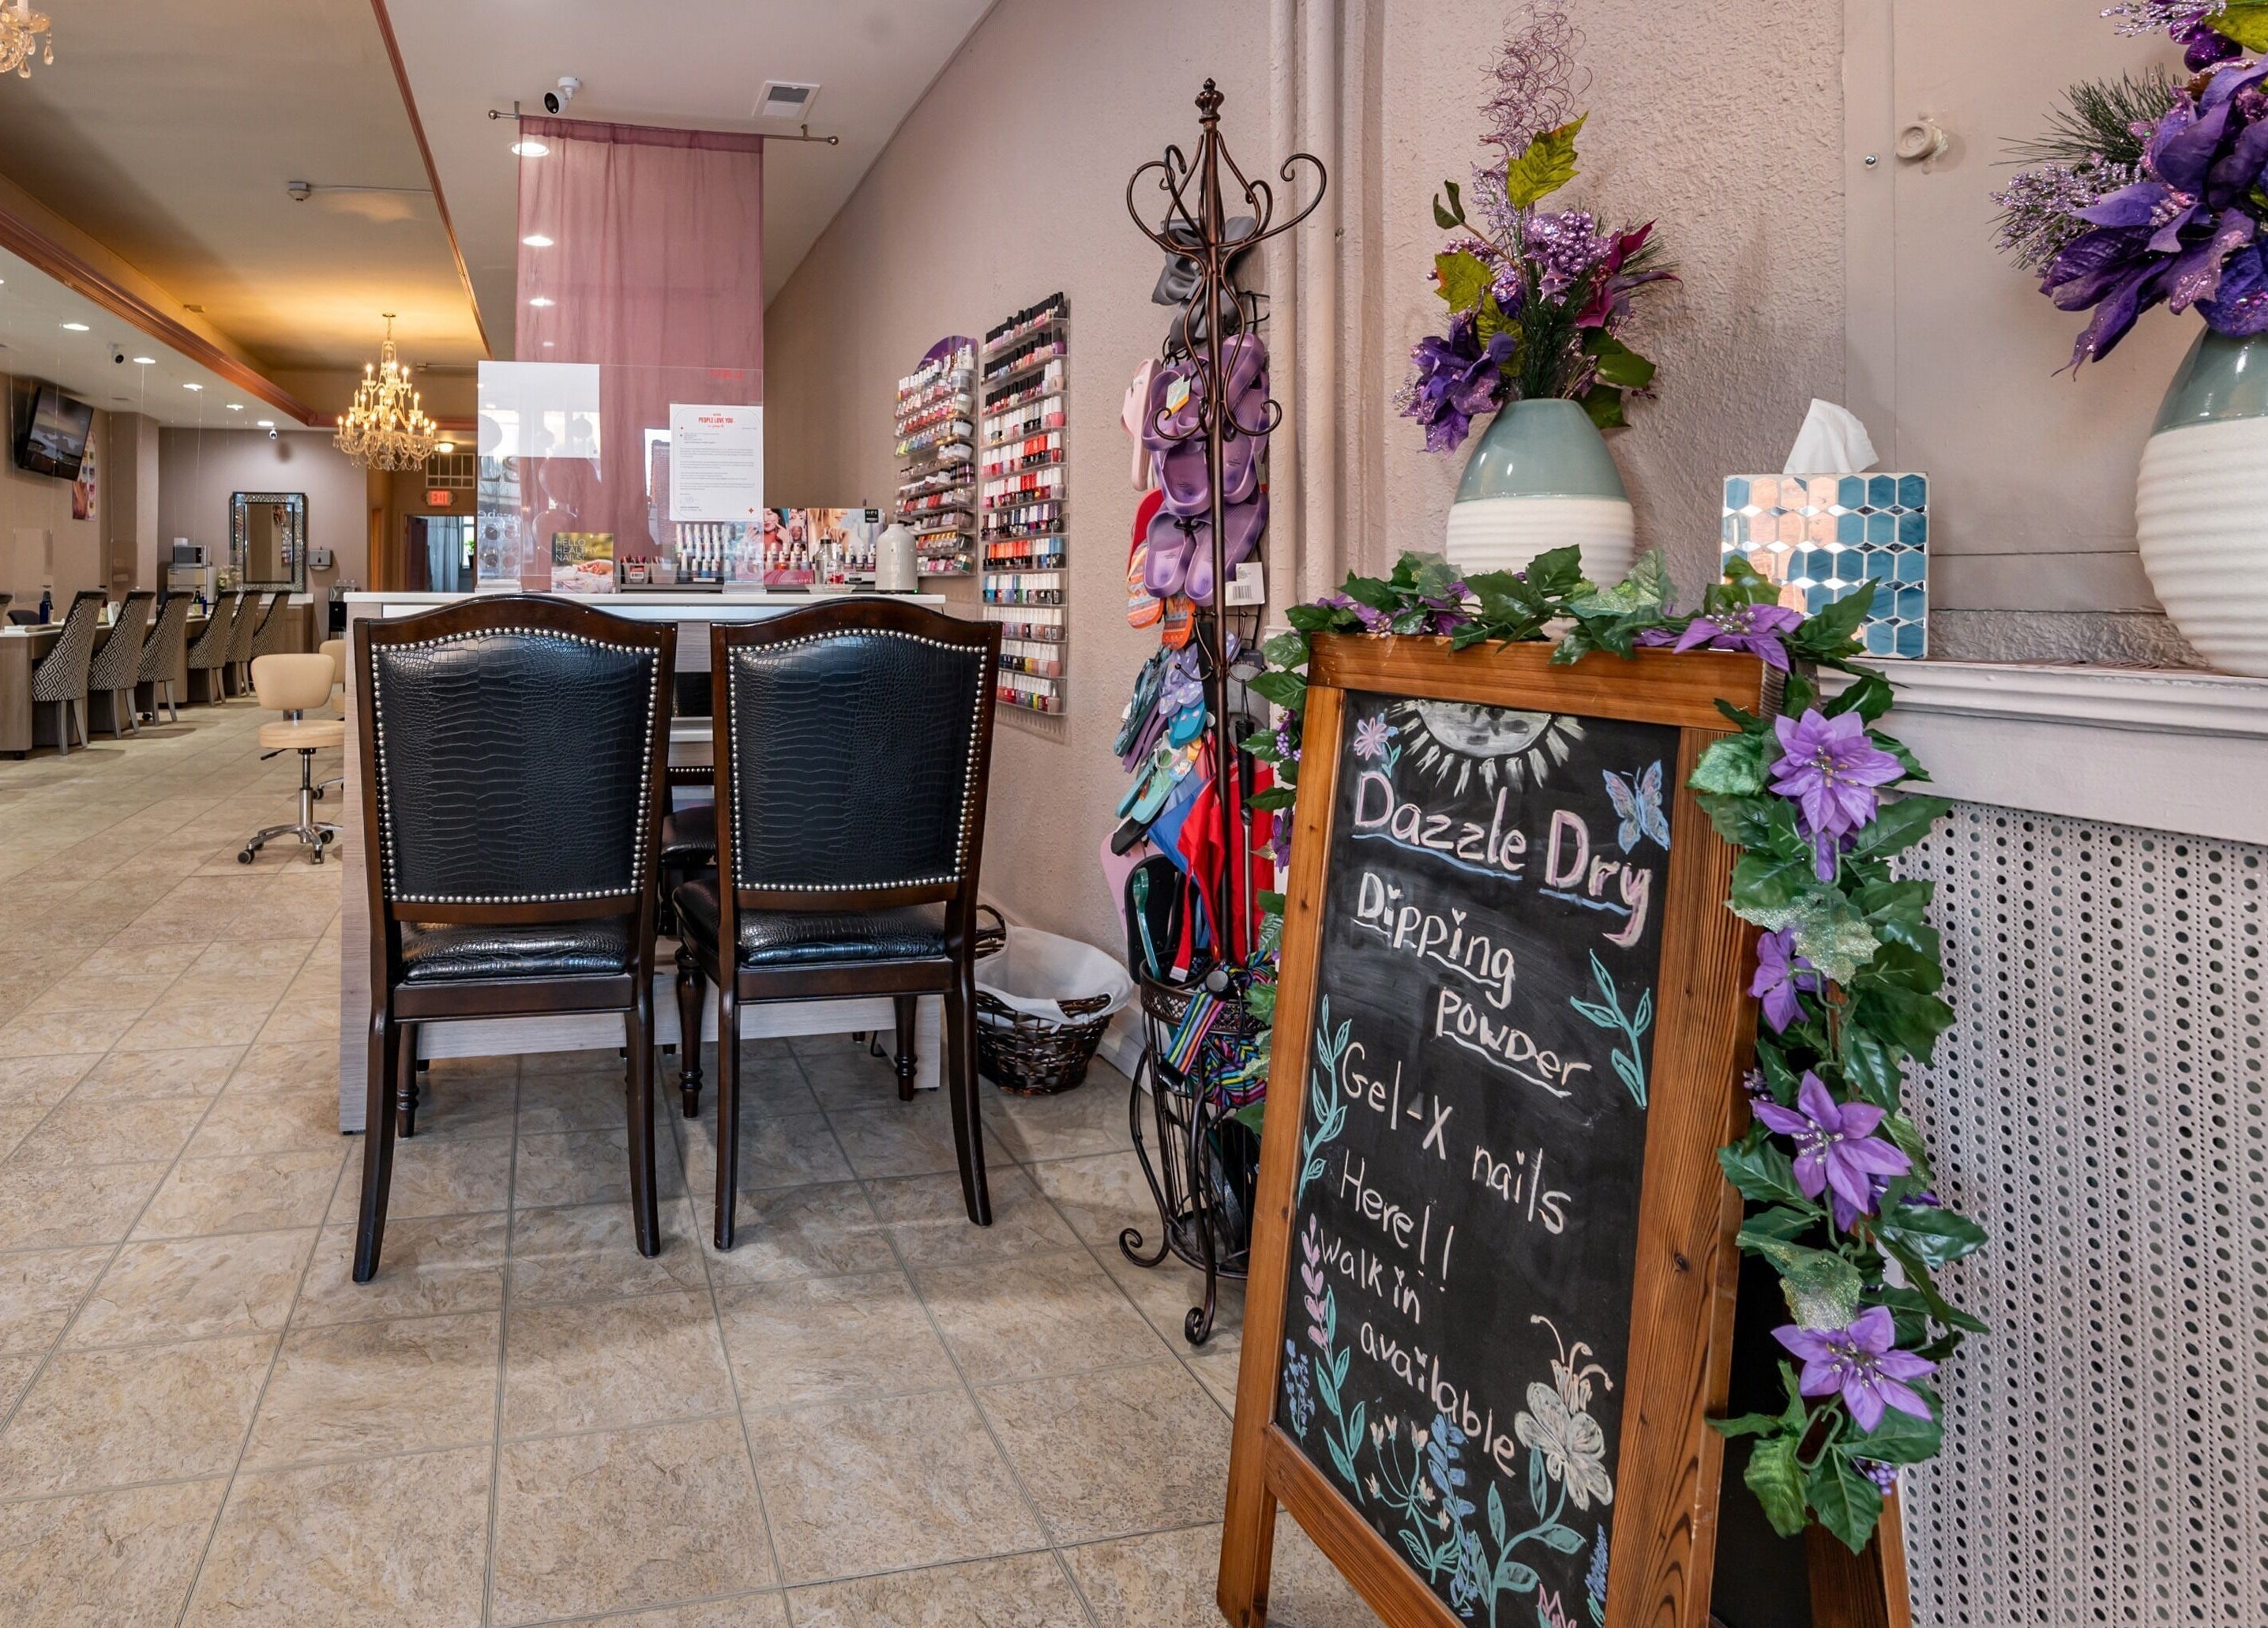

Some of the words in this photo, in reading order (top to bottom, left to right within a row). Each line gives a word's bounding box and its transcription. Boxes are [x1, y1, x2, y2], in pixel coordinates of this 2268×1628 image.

[555, 538, 586, 547] HELLO
[1354, 771, 1526, 870] Dazzle
[1545, 810, 1651, 947] Dry
[1357, 872, 1515, 1009] Dipping
[1342, 1042, 1452, 1160] Gel-X
[1472, 1145, 1571, 1234] nails
[1393, 1265, 1421, 1324] in
[1361, 1322, 1515, 1476] available
